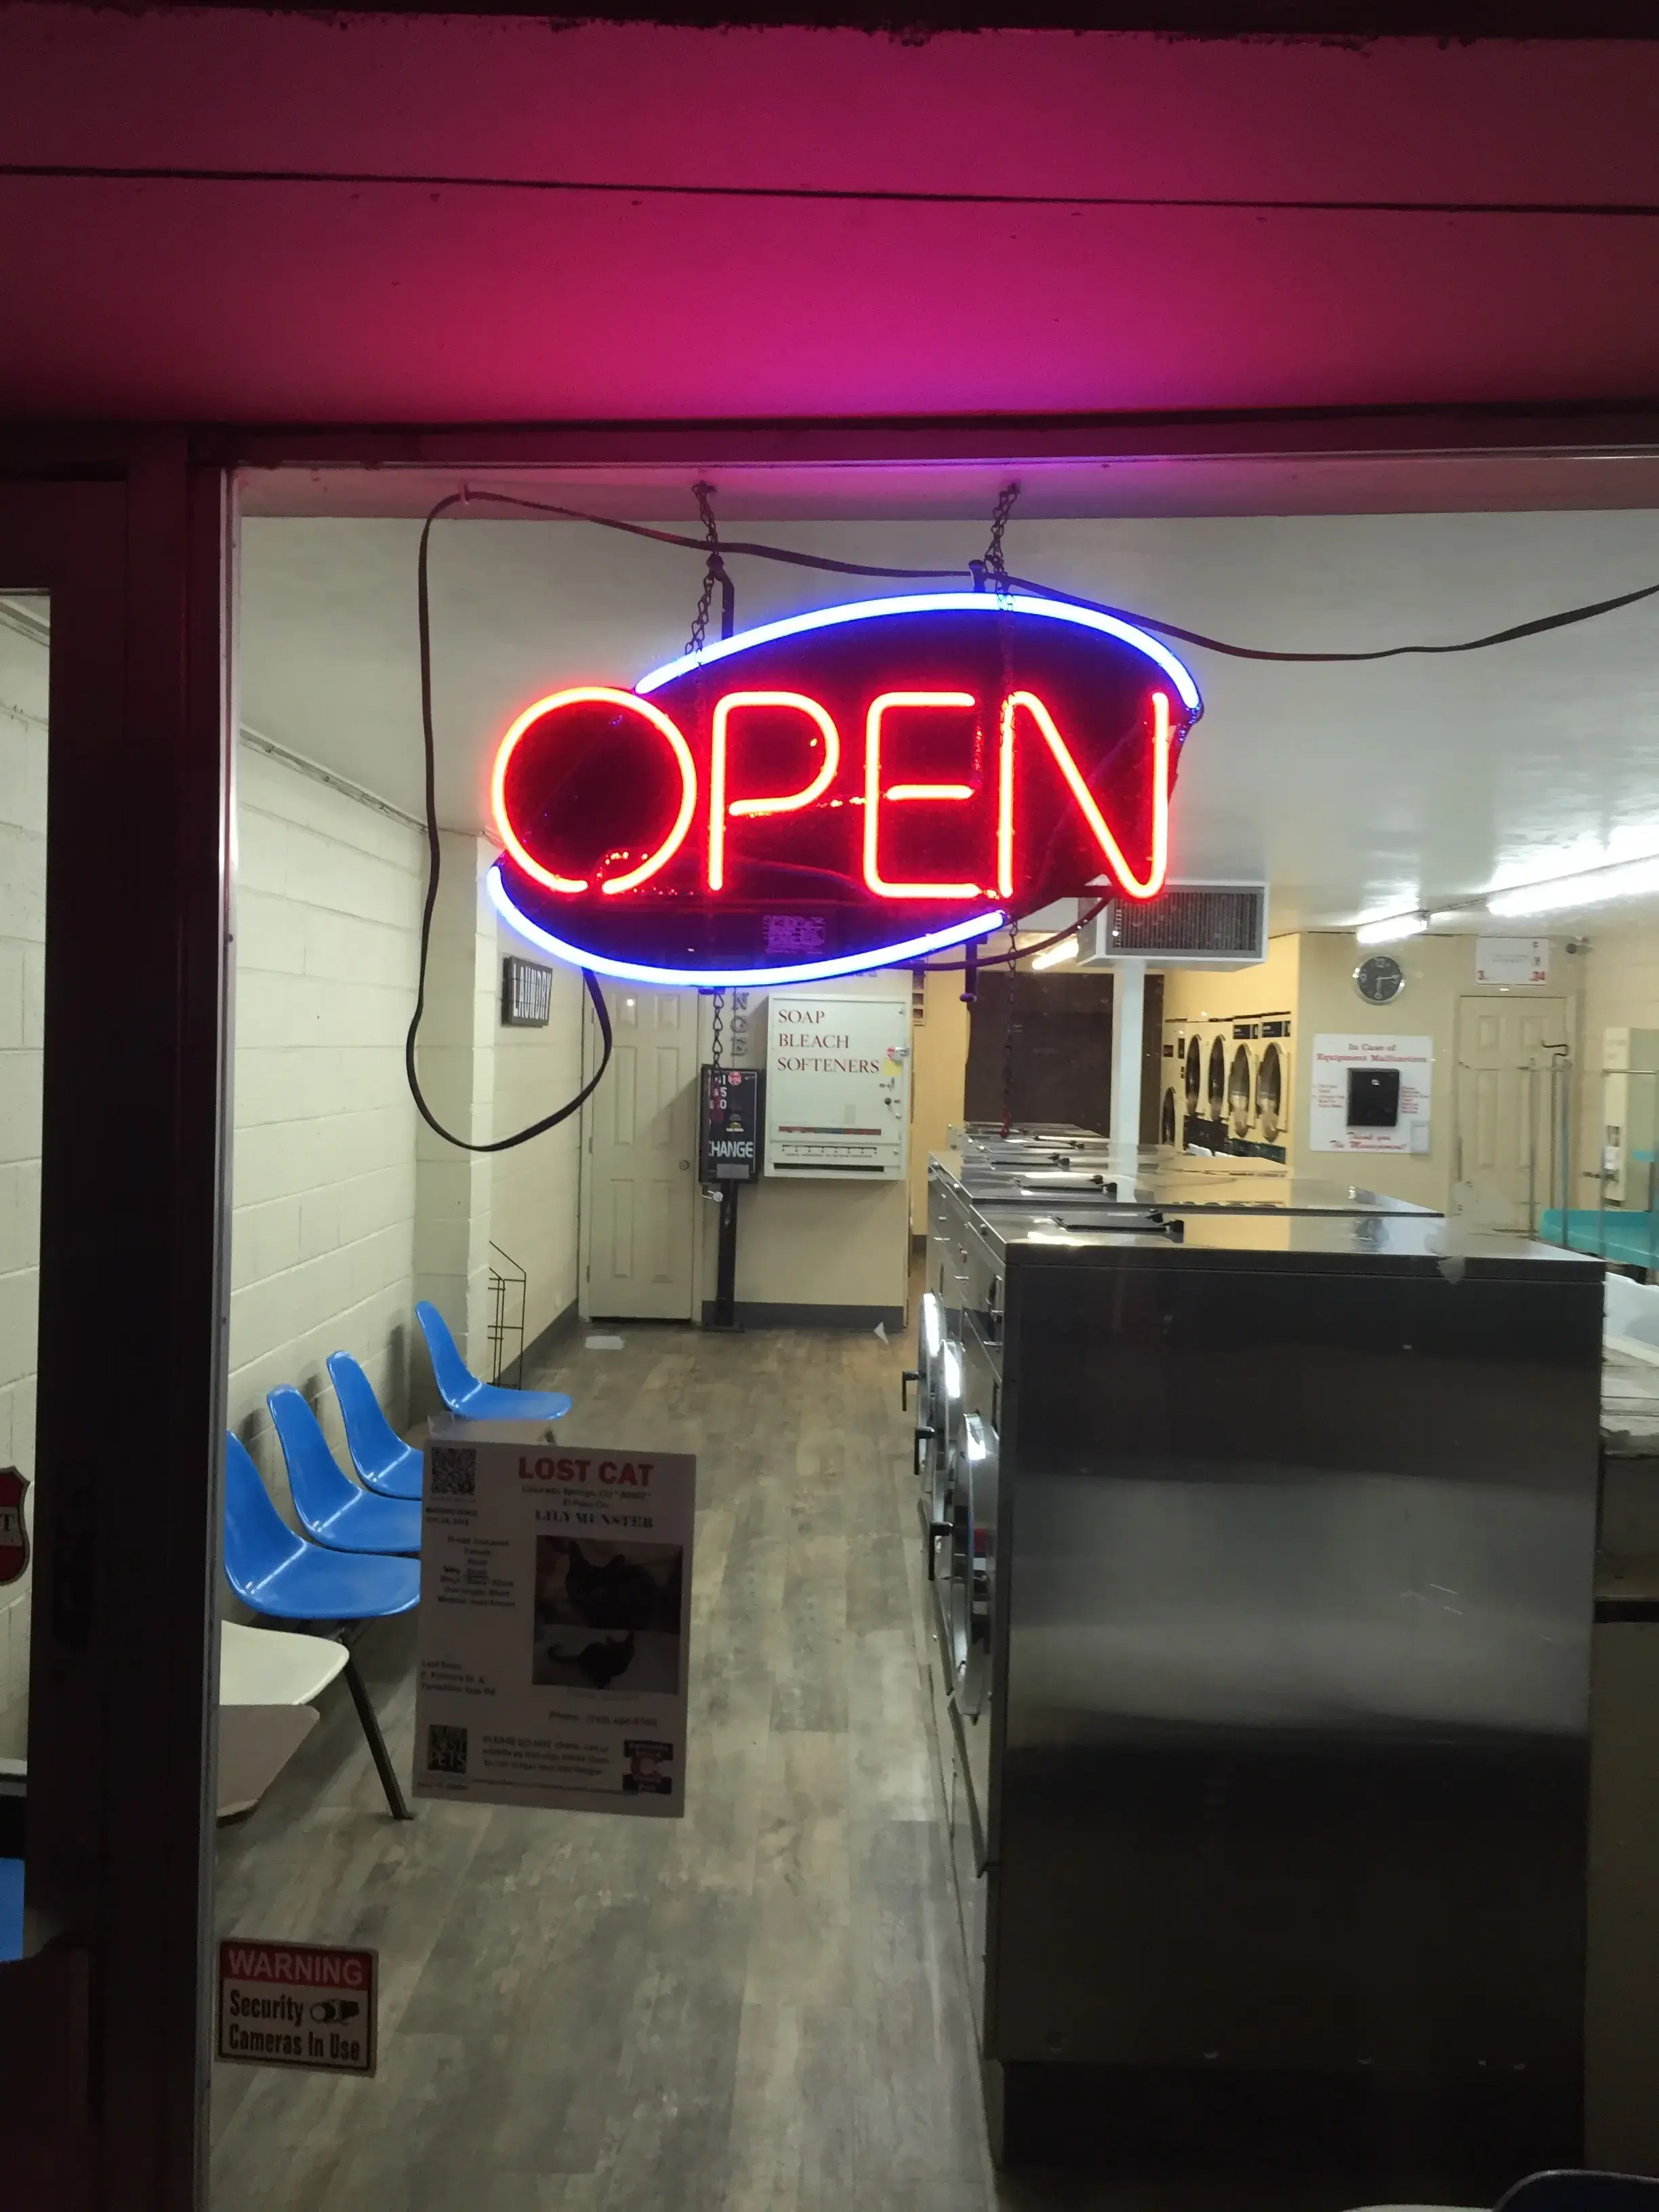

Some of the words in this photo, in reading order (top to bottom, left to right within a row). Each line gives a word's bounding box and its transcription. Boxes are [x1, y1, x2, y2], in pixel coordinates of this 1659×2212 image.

[491, 686, 1168, 901] OPEN
[777, 1008, 825, 1024] SOAP
[777, 1033, 849, 1049] BLEACH
[777, 1057, 880, 1074] SOFTENERS
[518, 1456, 591, 1482] LOST
[598, 1460, 655, 1486] CAT
[229, 1949, 363, 1986] WARNING
[230, 1989, 304, 2028] Security
[228, 2023, 302, 2057] Cameras
[308, 2030, 324, 2057] In
[330, 2033, 361, 2062] Use
